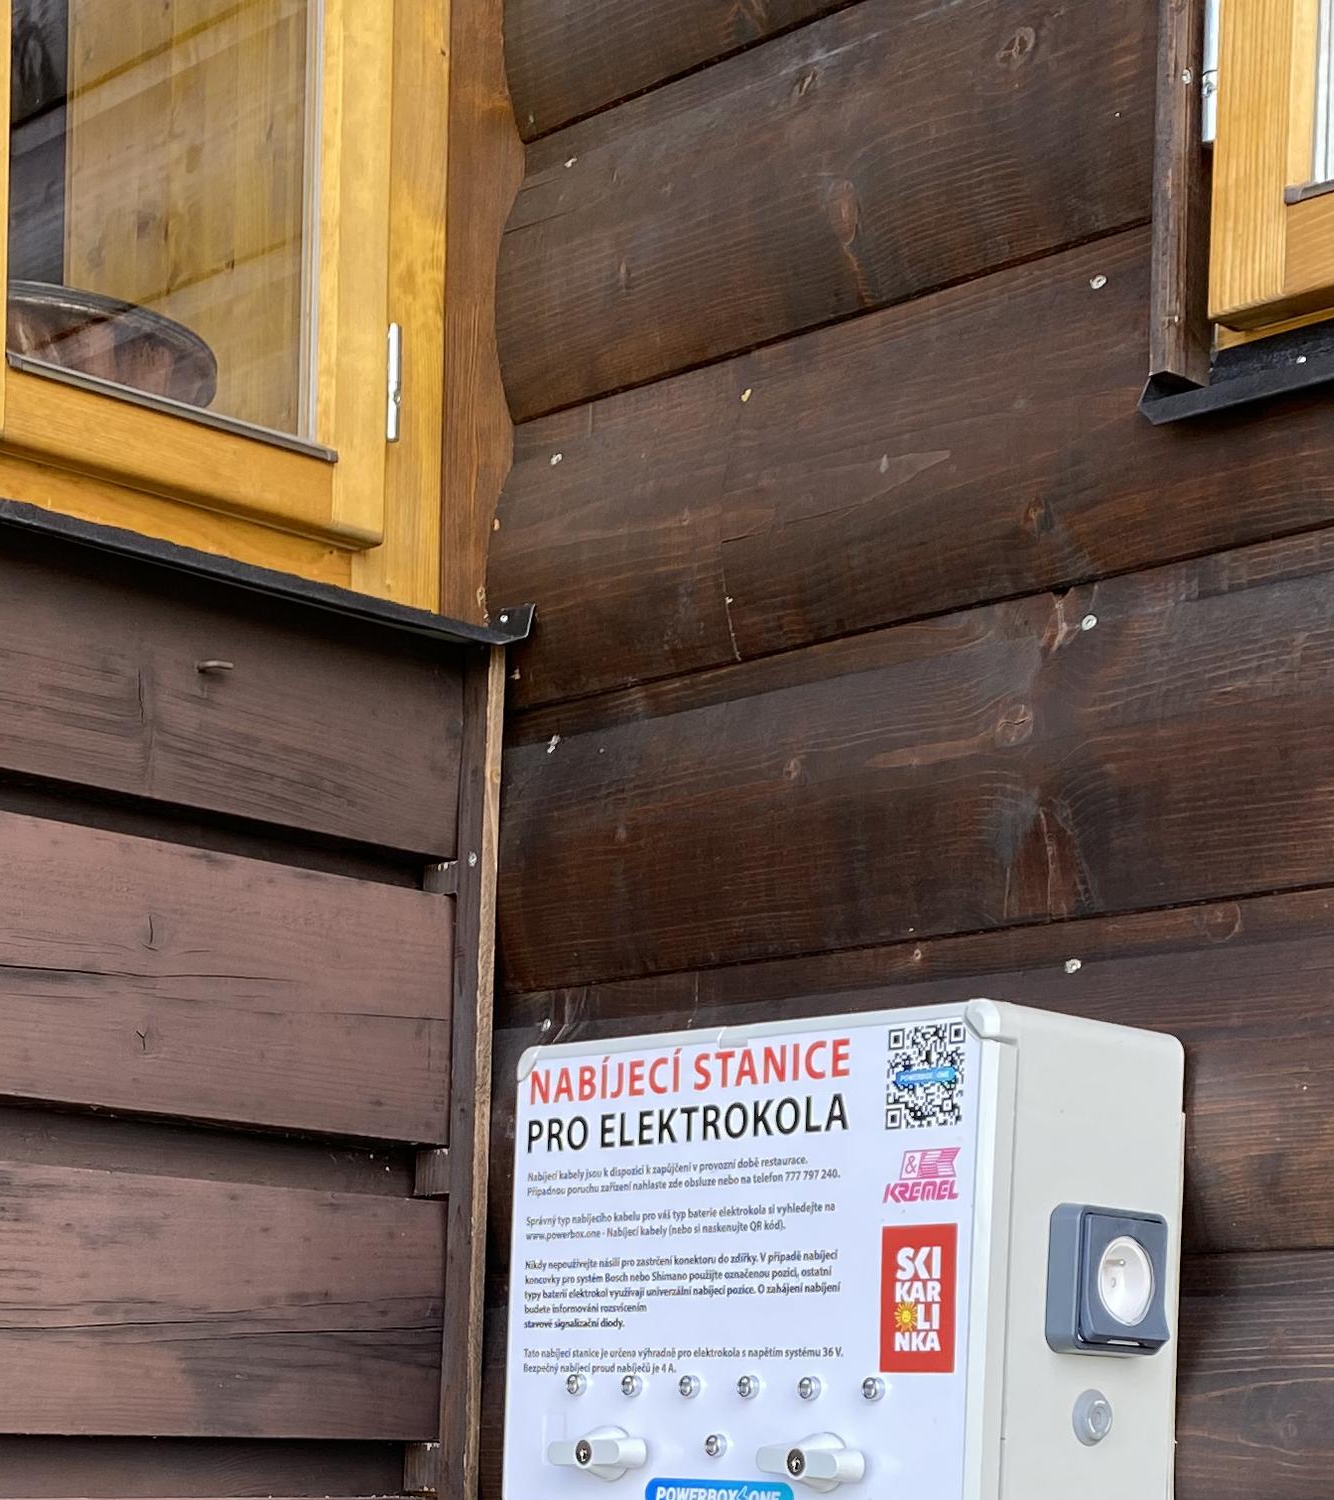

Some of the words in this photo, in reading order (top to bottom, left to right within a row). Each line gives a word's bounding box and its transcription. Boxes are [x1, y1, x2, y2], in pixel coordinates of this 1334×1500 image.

[530, 1048, 682, 1105] NABÍJECÍ
[694, 1038, 850, 1090] STANICE
[528, 1116, 588, 1153] PRO
[600, 1093, 848, 1149] ELEKTROKOLA
[528, 1170, 557, 1183] Nabíjecí
[559, 1169, 584, 1180] kabely
[585, 1170, 602, 1181] jsou
[604, 1168, 608, 1176] k
[646, 1164, 650, 1174] k
[653, 1162, 691, 1175] zapůjčení
[699, 1159, 736, 1173] provozní
[738, 1158, 759, 1168] době
[761, 1156, 808, 1167] restaurace.
[527, 1186, 565, 1197] Případnou
[567, 1183, 599, 1196] poruchu
[601, 1182, 632, 1191] zařízení
[633, 1180, 666, 1190] nahlaste
[668, 1178, 682, 1188] zde
[685, 1177, 716, 1188] obsluze
[718, 1175, 739, 1185] nebo
[741, 1175, 751, 1184] na
[753, 1172, 783, 1183] telefon
[785, 1171, 801, 1181] 777
[803, 1170, 818, 1180] 797
[821, 1169, 840, 1179] 240.
[883, 1179, 958, 1204] KREMEL
[526, 1215, 556, 1228] Správný
[558, 1216, 570, 1227] typ
[572, 1213, 612, 1225] nabíjecího
[614, 1211, 640, 1222] kabelu
[642, 1212, 656, 1223] pro
[658, 1210, 670, 1219] váš
[673, 1211, 686, 1221] typ
[688, 1208, 717, 1218] baterie
[719, 1205, 766, 1217] elektrokola
[768, 1205, 775, 1214] si
[777, 1202, 822, 1216] vyhledejte
[825, 1203, 835, 1211] na
[526, 1229, 600, 1241] www.powerbox.one
[607, 1226, 639, 1240] Nabíjecí
[641, 1225, 667, 1238] kabely
[669, 1224, 692, 1235] (nebo
[694, 1223, 700, 1233] si
[702, 1222, 748, 1234] naskenujte
[750, 1221, 762, 1232] QR
[764, 1219, 786, 1231] kód).
[526, 1260, 546, 1271] Nikdy
[621, 1259, 634, 1268] pro
[636, 1257, 672, 1266] zastrčení
[674, 1255, 716, 1265] konektoru
[718, 1254, 729, 1264] do
[760, 1253, 767, 1262] V
[768, 1251, 801, 1264] případě
[803, 1249, 838, 1263] nabíjecí
[896, 1246, 941, 1280] SKI
[525, 1274, 560, 1285] koncovky
[562, 1276, 575, 1285] pro
[577, 1274, 603, 1286] systém
[605, 1273, 628, 1282] Bosch
[630, 1272, 650, 1281] nebo
[652, 1270, 687, 1281] Shimano
[689, 1269, 722, 1282] použijte
[724, 1268, 769, 1279] označenou
[801, 1266, 832, 1277] ostatní
[525, 1291, 541, 1301] typy
[569, 1288, 607, 1298] elektrokol
[647, 1285, 691, 1296] univerzální
[693, 1286, 725, 1297] nabíjecí
[727, 1285, 756, 1297] pozice.
[758, 1284, 764, 1293] O
[767, 1283, 803, 1295] zahájení
[805, 1282, 840, 1294] nabíjení
[895, 1281, 941, 1302] KAR
[525, 1304, 550, 1313] budete
[524, 1319, 552, 1328] stavové
[554, 1318, 599, 1330] signalizační
[601, 1318, 625, 1330] diody.
[524, 1348, 540, 1357] Tato
[541, 1348, 571, 1359] nabíjecí
[573, 1348, 599, 1357] stanice
[601, 1348, 608, 1359] je
[610, 1348, 636, 1358] určena
[638, 1348, 676, 1359] výhradně
[678, 1349, 691, 1359] pro
[694, 1347, 740, 1357] elektrokola
[748, 1347, 783, 1359] napětím
[785, 1347, 821, 1359] systému
[823, 1347, 833, 1357] 36
[835, 1346, 843, 1357] V.
[894, 1332, 941, 1351] NKA
[524, 1363, 558, 1374] Bezpečný
[560, 1363, 590, 1374] nabíjecí
[592, 1363, 615, 1374] proud
[652, 1363, 659, 1374] je
[661, 1364, 666, 1373] 4
[668, 1363, 676, 1373] A.
